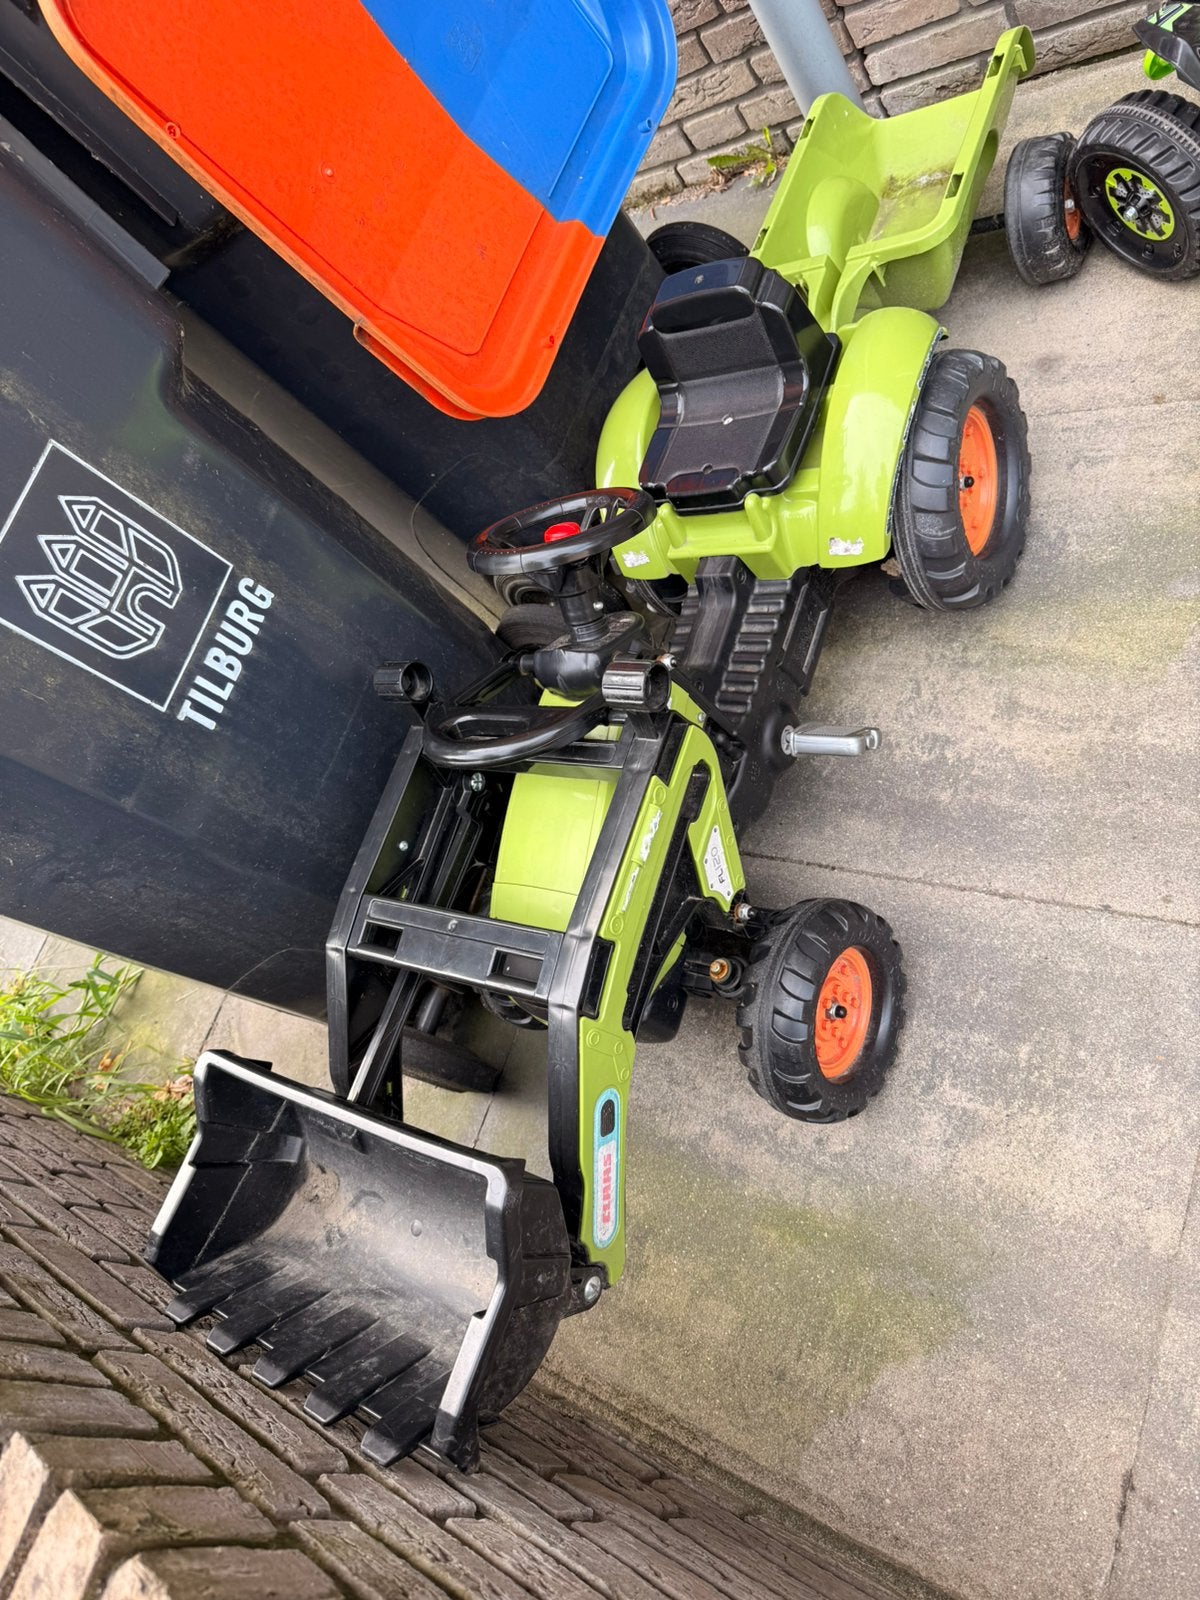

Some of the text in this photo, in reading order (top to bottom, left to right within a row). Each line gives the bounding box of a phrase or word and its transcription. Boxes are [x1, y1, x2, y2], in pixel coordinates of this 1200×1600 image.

[177, 577, 275, 730] TILBURG
[710, 846, 726, 884] FL120
[602, 1153, 611, 1224] CLAAS
